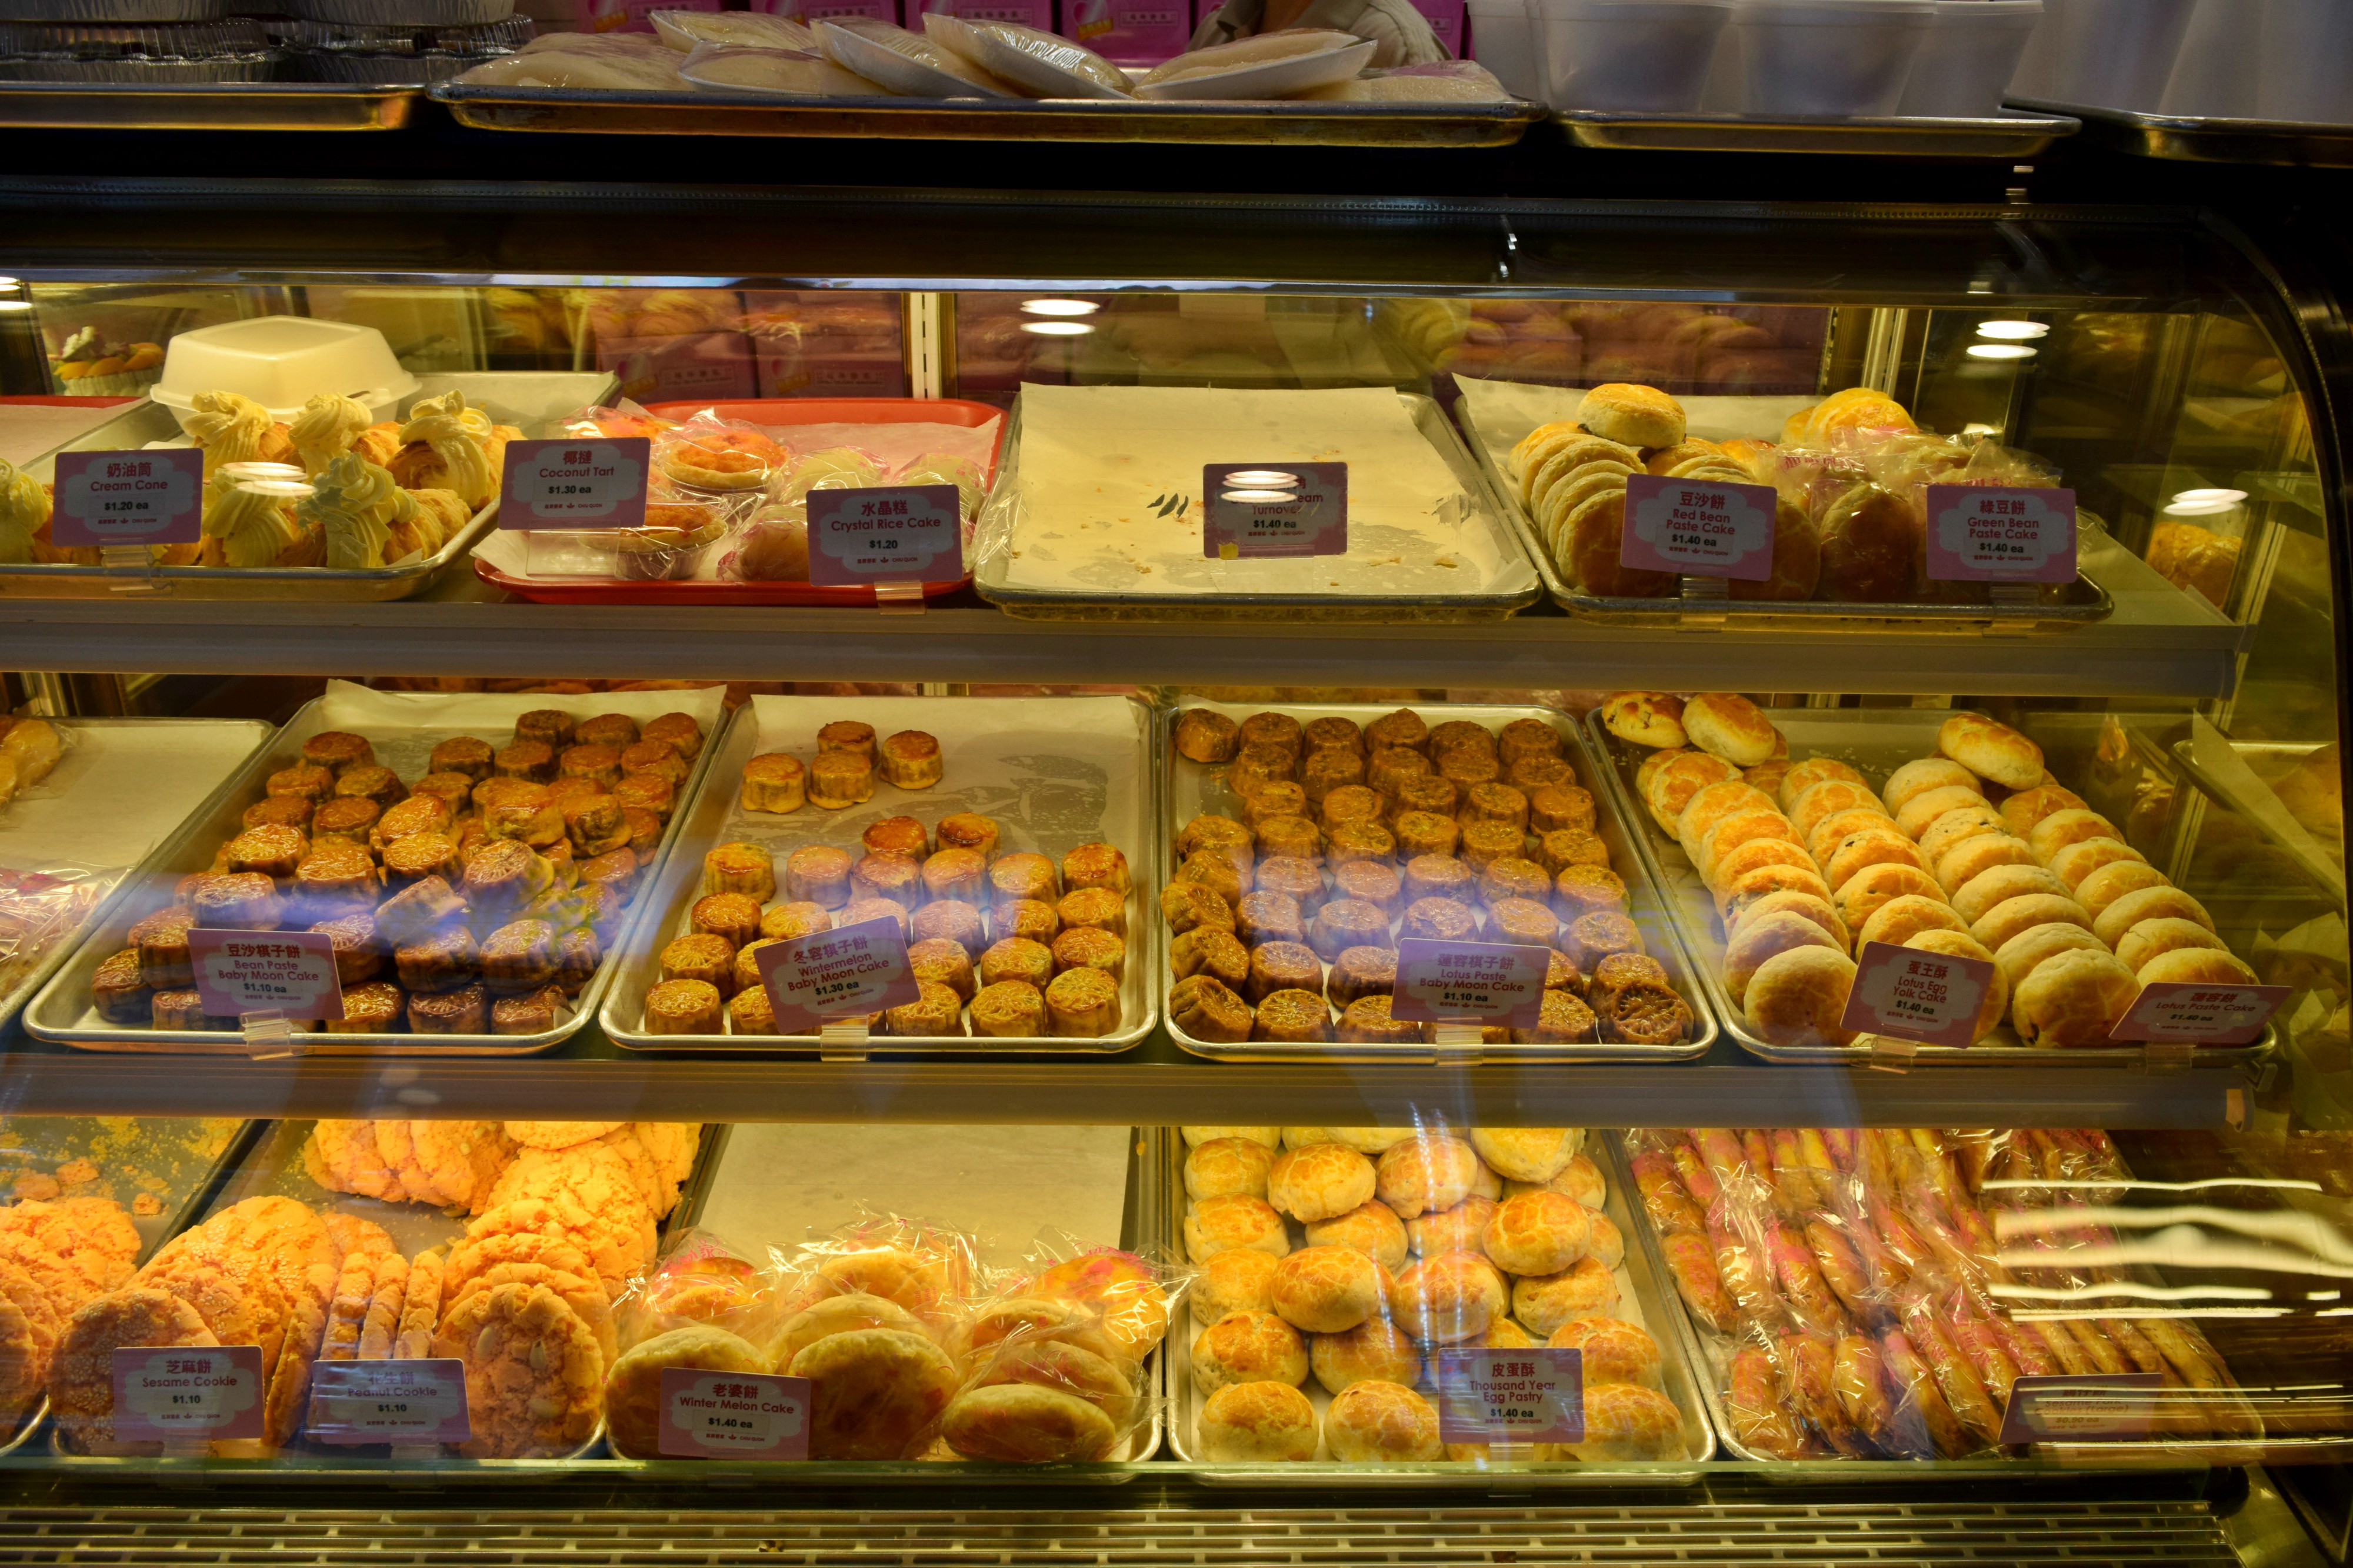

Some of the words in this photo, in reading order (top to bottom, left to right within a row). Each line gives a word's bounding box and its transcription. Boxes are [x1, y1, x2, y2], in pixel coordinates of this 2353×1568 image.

[563, 451, 592, 465] 椰撻
[106, 462, 152, 478] 奶油筒
[539, 467, 591, 478] Coconut
[594, 466, 615, 476] Tart
[91, 482, 131, 492] Cream
[135, 480, 168, 490] Cone
[104, 502, 132, 511] $1.20
[1679, 491, 1725, 510] 豆沙餅
[861, 500, 908, 516] 水晶糕
[1980, 500, 2025, 515] 綠豆餅
[1673, 509, 1696, 520] Red
[1700, 511, 1731, 523] Bean
[832, 519, 873, 532] Crystal
[878, 519, 904, 529] Rice
[908, 517, 941, 528] Cake
[1667, 519, 1699, 532] Paste
[1702, 522, 1735, 535] Cake
[1968, 517, 2005, 528] Green
[2009, 518, 2039, 529] Bean
[1672, 534, 1701, 545] $1.40
[1704, 538, 1717, 546] ea
[1969, 529, 2001, 539] Paste
[2005, 529, 2038, 539] Cake
[869, 541, 898, 549] $1.20
[1980, 543, 2008, 552] $1.40
[2011, 545, 2024, 553] ea
[227, 943, 300, 958] 豆沙棋子餅
[794, 934, 868, 965] 冬容棋子餅
[235, 960, 264, 969] Bean
[268, 961, 298, 970] Paste
[798, 953, 872, 978] Wintermelon
[1438, 953, 1514, 970] 蓮容棋子餅
[218, 970, 247, 981] Baby
[251, 971, 284, 980] Moon
[288, 972, 318, 981] Cake
[788, 977, 818, 992] Baby
[821, 968, 855, 983] Moon
[857, 959, 889, 973] Cake
[1441, 969, 1471, 980] Lotus
[1474, 971, 1507, 981] Paste
[1907, 960, 1948, 980] 蛋王酥
[244, 983, 271, 992] $1.10
[815, 985, 843, 995] $1.30
[846, 982, 859, 990] ea
[1420, 978, 1450, 989] Baby
[1454, 980, 1488, 989] Moon
[1492, 982, 1525, 992] Cake
[1898, 976, 1925, 989] Lotus
[1928, 980, 1947, 994] Egg
[1444, 992, 1472, 1000] $1.10
[1894, 986, 1915, 999] Yolk
[1918, 990, 1947, 1003] Cake
[1896, 1000, 1921, 1012] $1.40
[1923, 1006, 1935, 1015] ea
[2188, 1003, 2221, 1011] Paste
[166, 1359, 212, 1374] 芝麻餅
[1492, 1363, 1535, 1377] 皮蛋酥
[142, 1377, 190, 1387] Sesame
[194, 1376, 237, 1386] Cookie
[1469, 1380, 1525, 1390] Thousand
[1529, 1380, 1555, 1390] Year
[348, 1387, 390, 1397] Peanut
[394, 1387, 437, 1396] Cookie
[713, 1383, 758, 1399] 老婆餅
[1484, 1392, 1505, 1403] Egg
[1509, 1392, 1543, 1403] Pastry
[172, 1395, 201, 1404] $1.10
[680, 1397, 717, 1408] Winter
[721, 1400, 758, 1411] Melon
[762, 1402, 794, 1413] Cake
[1491, 1409, 1518, 1417] $1.40
[708, 1417, 736, 1427] $1.40
[740, 1420, 753, 1428] ea
